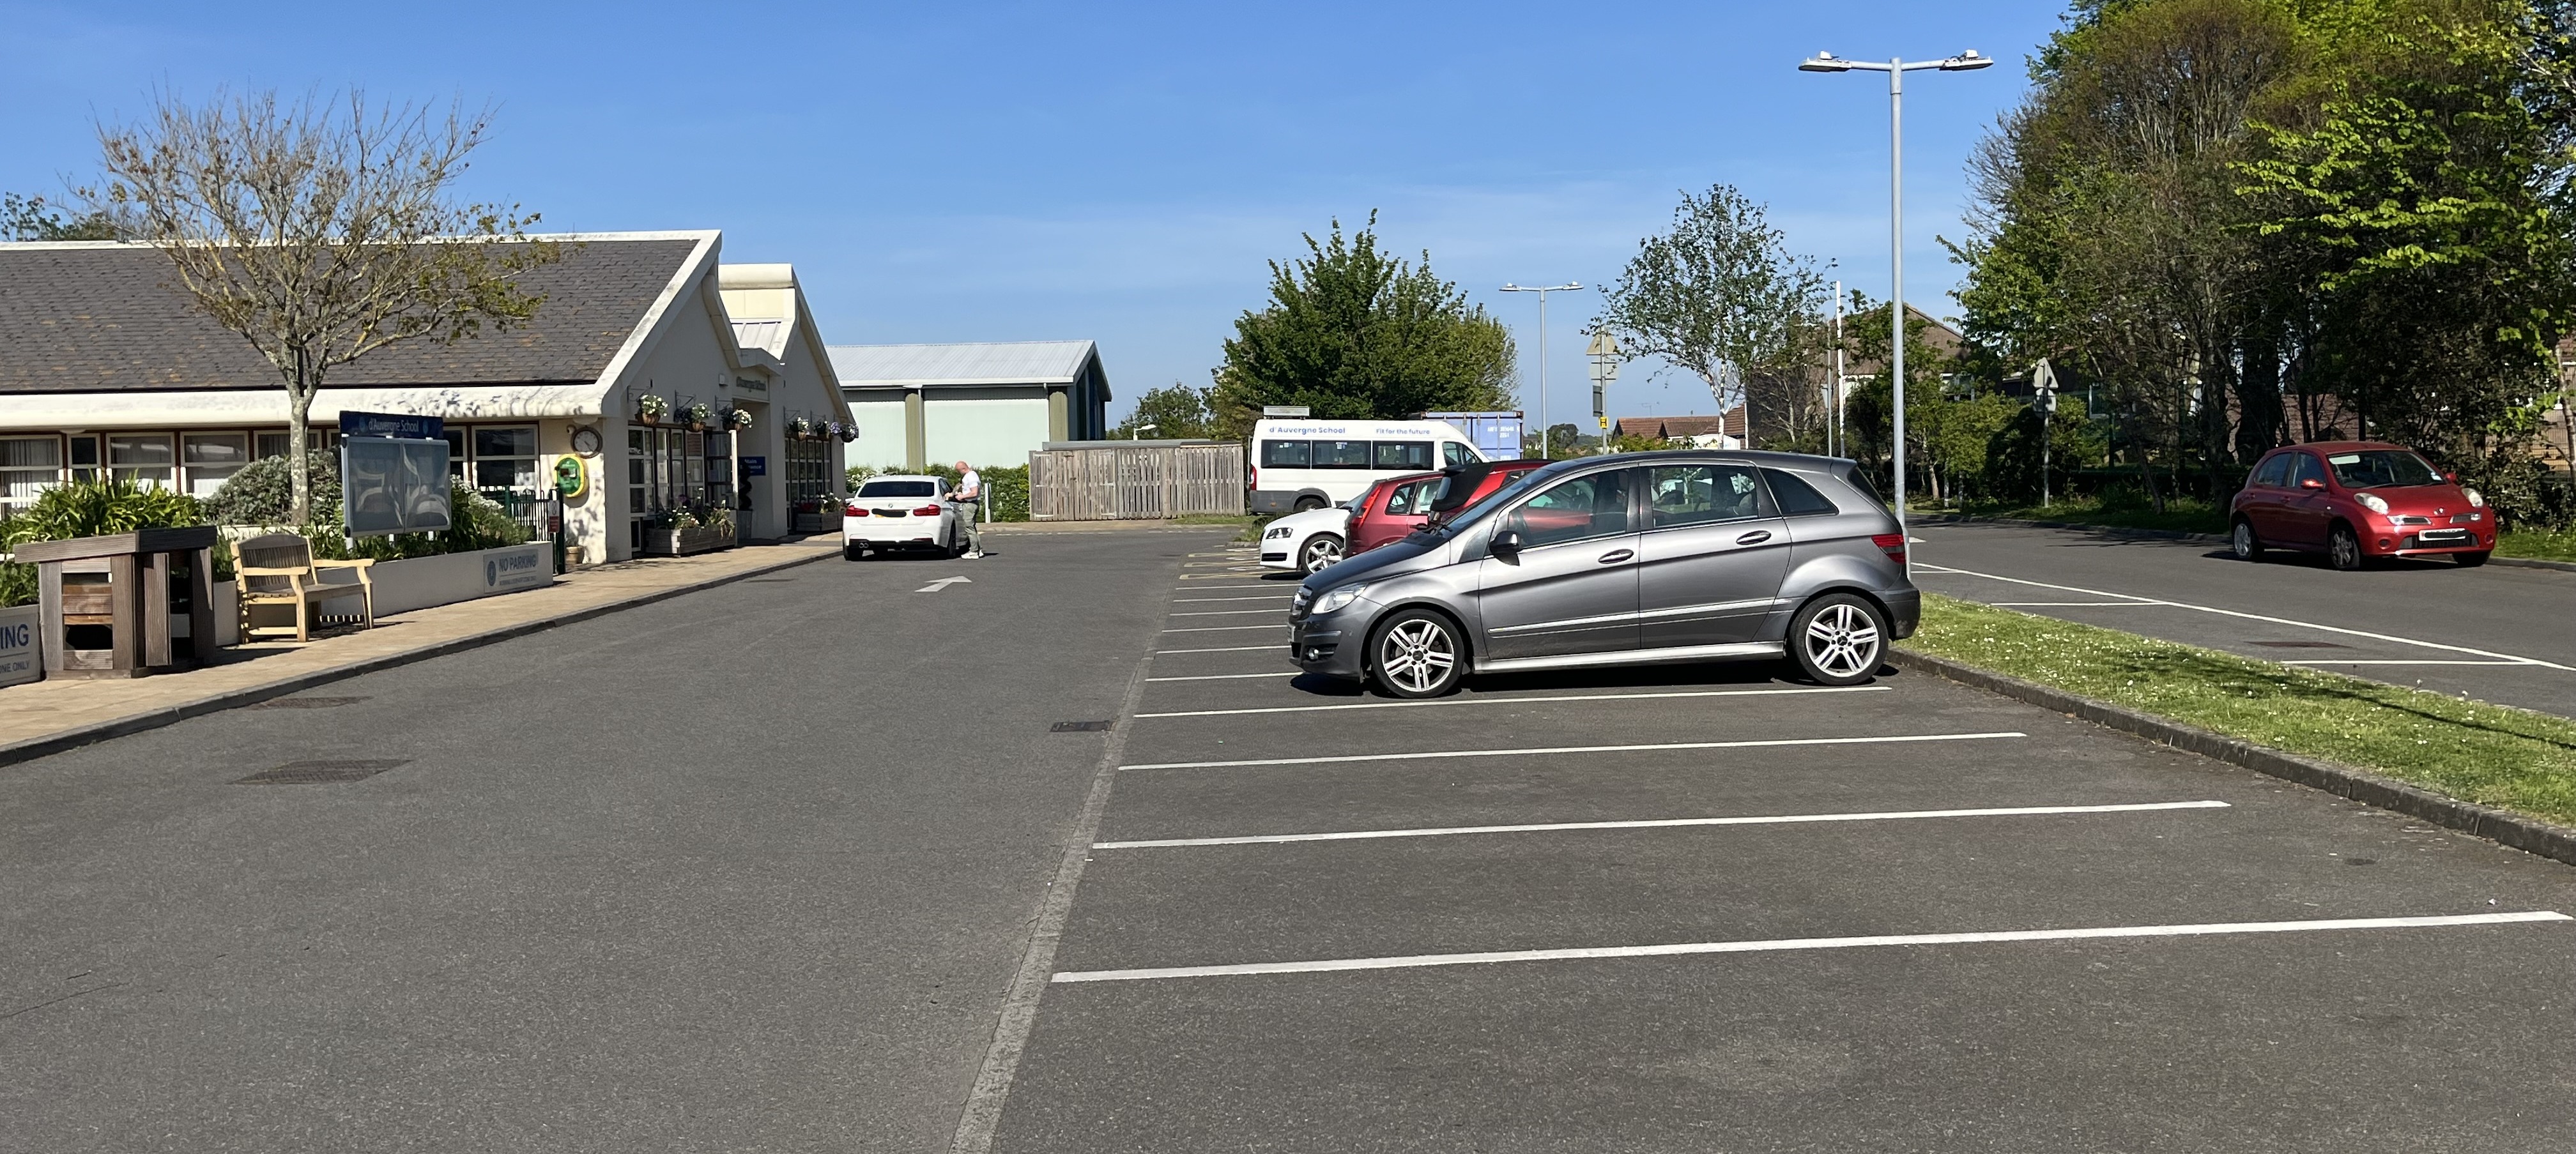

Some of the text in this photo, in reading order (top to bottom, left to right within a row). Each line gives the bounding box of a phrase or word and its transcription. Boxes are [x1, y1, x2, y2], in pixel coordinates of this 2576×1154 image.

[369, 418, 419, 432] d'Auvergne School
[1600, 418, 1607, 427] H
[499, 554, 536, 572] NO PARKING
[13, 660, 29, 671] ONLY
